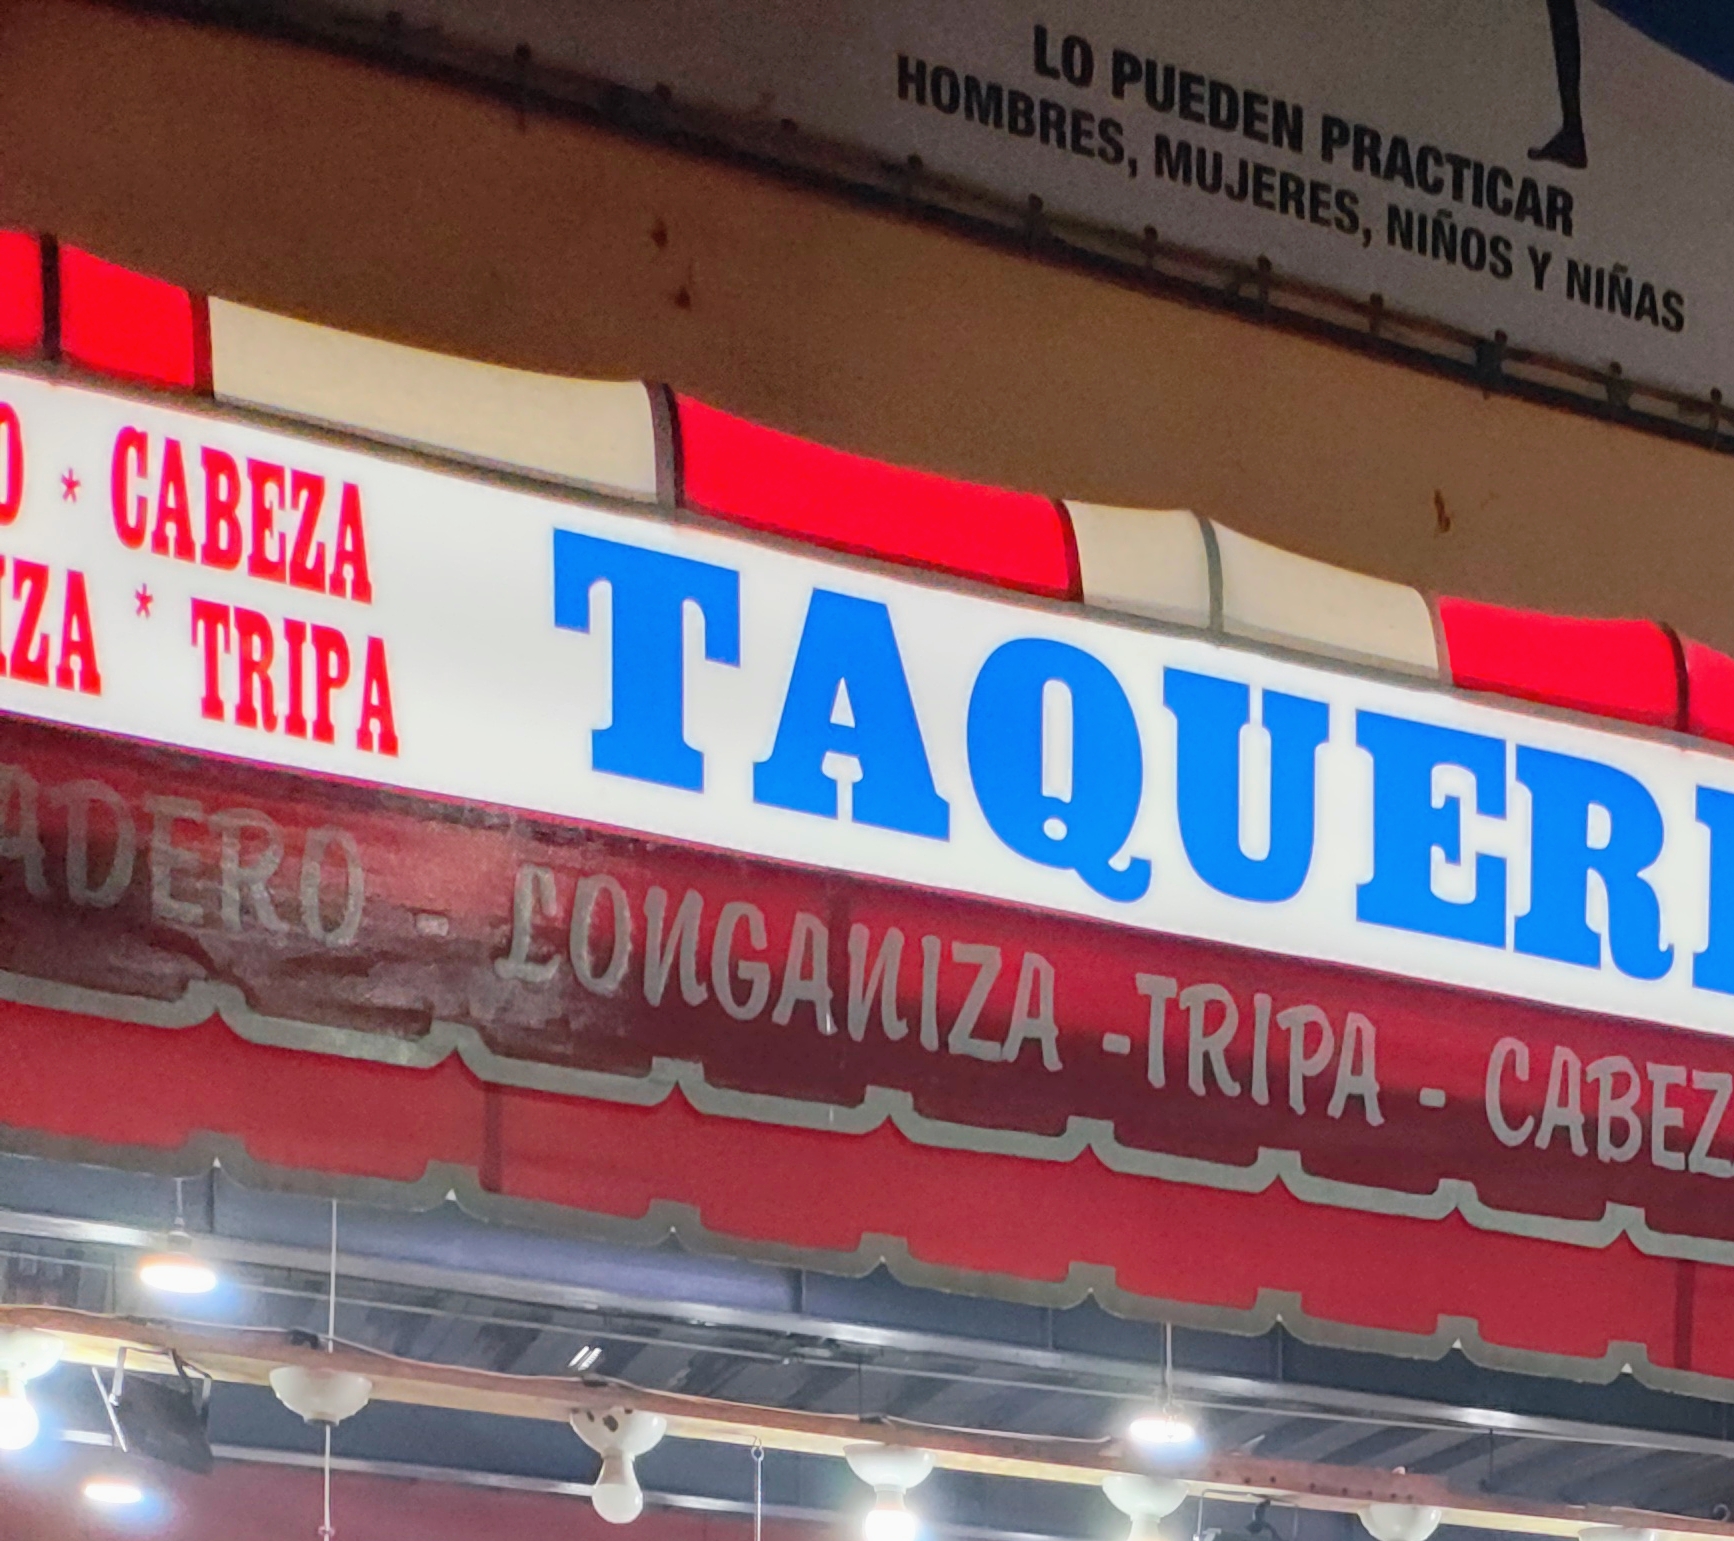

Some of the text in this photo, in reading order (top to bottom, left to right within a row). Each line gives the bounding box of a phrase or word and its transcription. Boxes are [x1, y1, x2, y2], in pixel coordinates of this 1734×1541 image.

[896, 54, 1686, 333] HOMBRES, MUJERES, NIÑOS Y NIÑAS
[1034, 23, 1575, 237] LO PUEDEN PRACTICAR
[110, 425, 372, 605] CABEZA
[0, 554, 399, 757] ZA TRIPA
[494, 864, 1062, 1072] LONGANIZA
